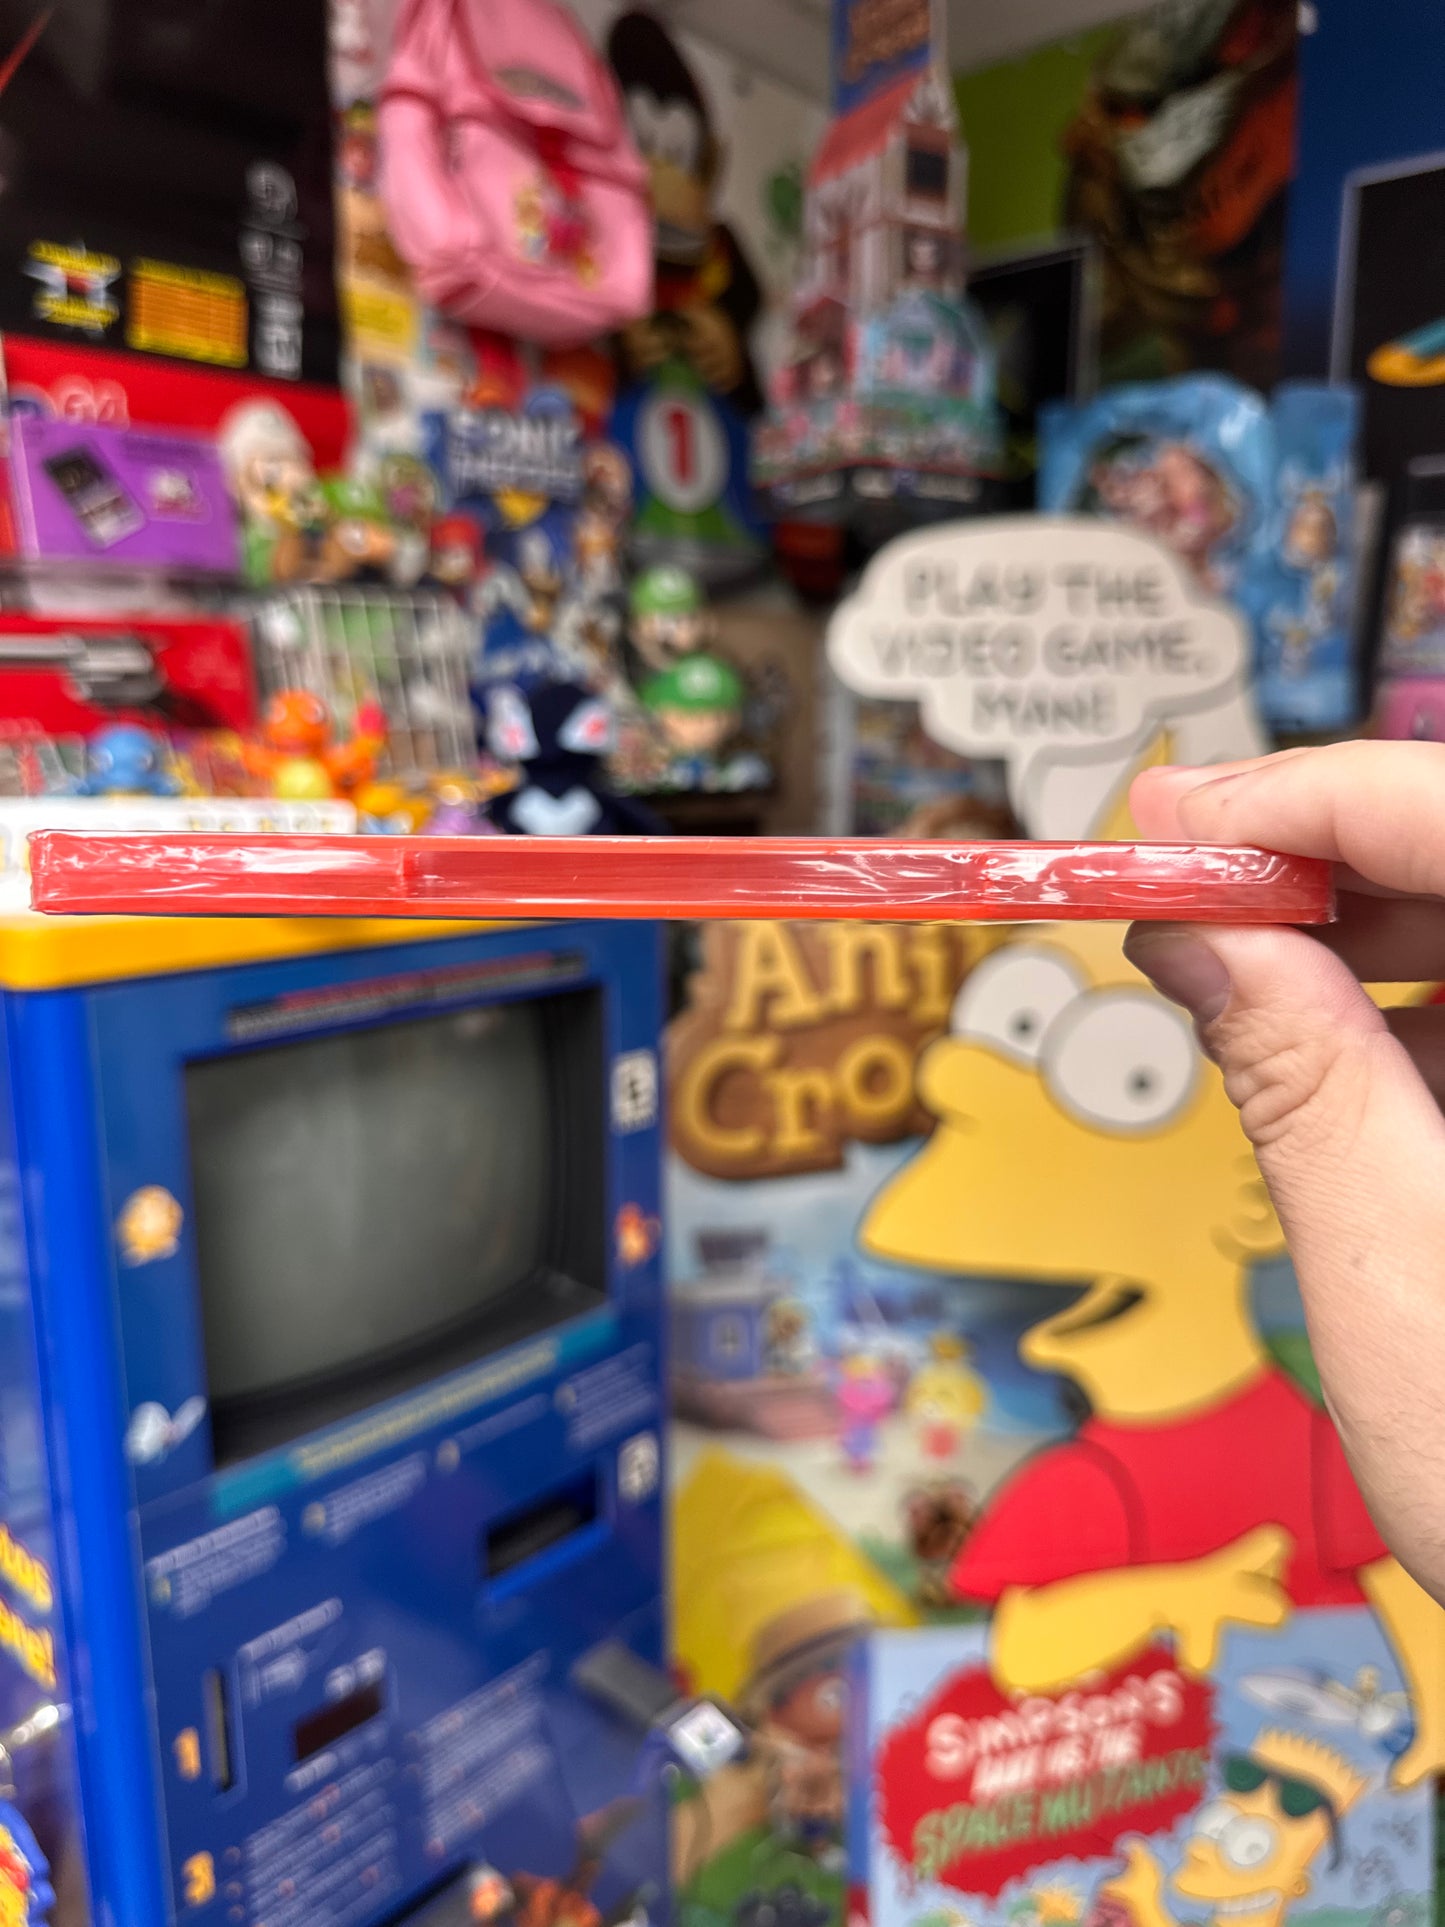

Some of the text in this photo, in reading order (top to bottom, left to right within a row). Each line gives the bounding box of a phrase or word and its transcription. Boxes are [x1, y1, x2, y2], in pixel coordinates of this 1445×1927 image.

[902, 557, 1168, 617] PLAY THE
[872, 622, 1038, 678] VIDEO
[724, 920, 1000, 1034] Ani
[672, 1034, 914, 1156] Cro
